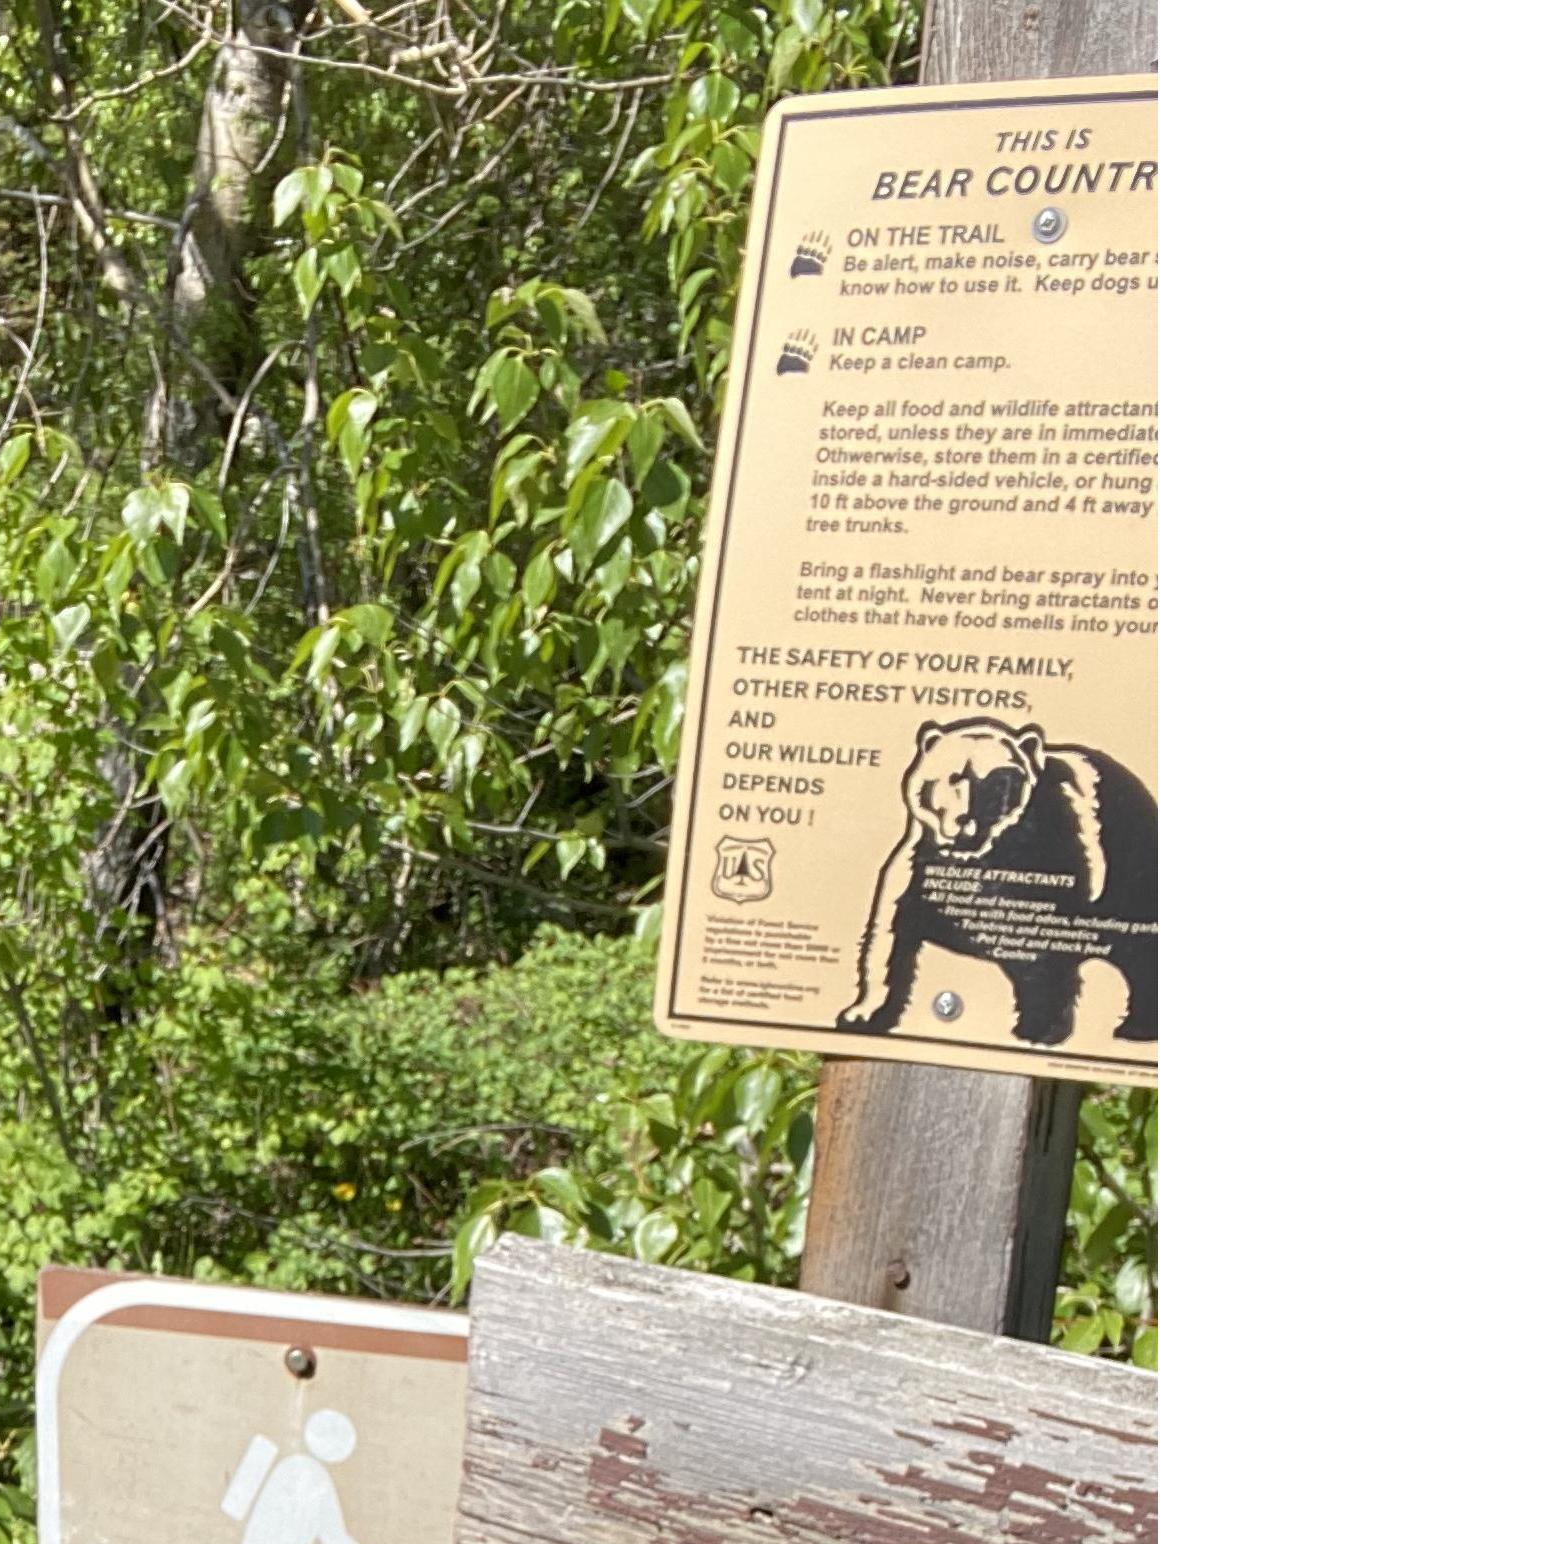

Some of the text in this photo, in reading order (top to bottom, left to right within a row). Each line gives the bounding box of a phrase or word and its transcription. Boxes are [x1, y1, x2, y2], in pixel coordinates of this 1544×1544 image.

[996, 128, 1093, 152] THIS IS
[872, 161, 1158, 200] BEAR COUNTR
[847, 224, 1006, 247] ON THE TRAIL
[844, 248, 1149, 273] Be alert, make noise, carry bear
[840, 279, 889, 296] know
[895, 278, 934, 295] how
[940, 277, 958, 293] to
[964, 280, 999, 293] use
[1006, 276, 1022, 293] it.
[1035, 274, 1084, 295] Keep
[1091, 272, 1140, 294] dogs
[833, 326, 927, 346] IN CAMP
[830, 353, 1012, 373] Keep a clean camp.
[823, 401, 869, 420] Keep
[875, 401, 897, 417] all
[901, 400, 944, 418] food
[950, 401, 985, 417] and
[992, 400, 1060, 417] wildlife
[819, 425, 882, 443] stored,
[888, 425, 949, 440] unless
[956, 425, 996, 445] they
[1002, 428, 1032, 441] are
[1039, 425, 1056, 440] in
[817, 448, 929, 467] Othwerwise,
[935, 449, 982, 465] store
[989, 449, 1036, 464] them
[1043, 449, 1061, 464] in
[1067, 453, 1077, 465] a
[812, 470, 1152, 494] inside a hard-sided vehicle, or hung
[810, 494, 1155, 518] 10 ft above the ground and 4 ft away
[806, 518, 909, 534] tree trunks.
[800, 561, 1148, 590] Bring a flashlight and bear spray into
[797, 584, 831, 601] tent
[836, 586, 853, 601] at
[858, 585, 909, 606] night.
[920, 588, 975, 606] Never
[981, 589, 1030, 610] bring
[1036, 591, 1141, 610] attractants
[794, 606, 858, 624] clothes
[865, 608, 899, 626] that
[904, 609, 948, 627] have
[954, 610, 996, 629] food
[1002, 613, 1064, 631] smells
[1071, 615, 1108, 633] into
[736, 646, 1075, 681] THE SAFETY OF YOUR FAMILY,
[733, 678, 1033, 713] OTHER FOREST VISITORS,
[728, 710, 776, 729] AND
[726, 741, 882, 767] OUR WILDLIFE
[722, 772, 825, 796] DEPENDS
[718, 803, 751, 823] ON
[757, 805, 802, 826] YOU
[924, 865, 1075, 888] WILDLIFE ATTRACTANTS
[946, 893, 973, 905] food
[975, 896, 997, 907] and
[998, 897, 1056, 912] beverages
[980, 909, 1005, 920] with
[1006, 910, 1034, 922] food
[1073, 915, 1129, 934] including
[1015, 925, 1039, 937] and
[1039, 928, 1099, 942] cosmetics
[998, 935, 1025, 948] food
[1025, 939, 1050, 951] and
[1050, 941, 1082, 953] stock
